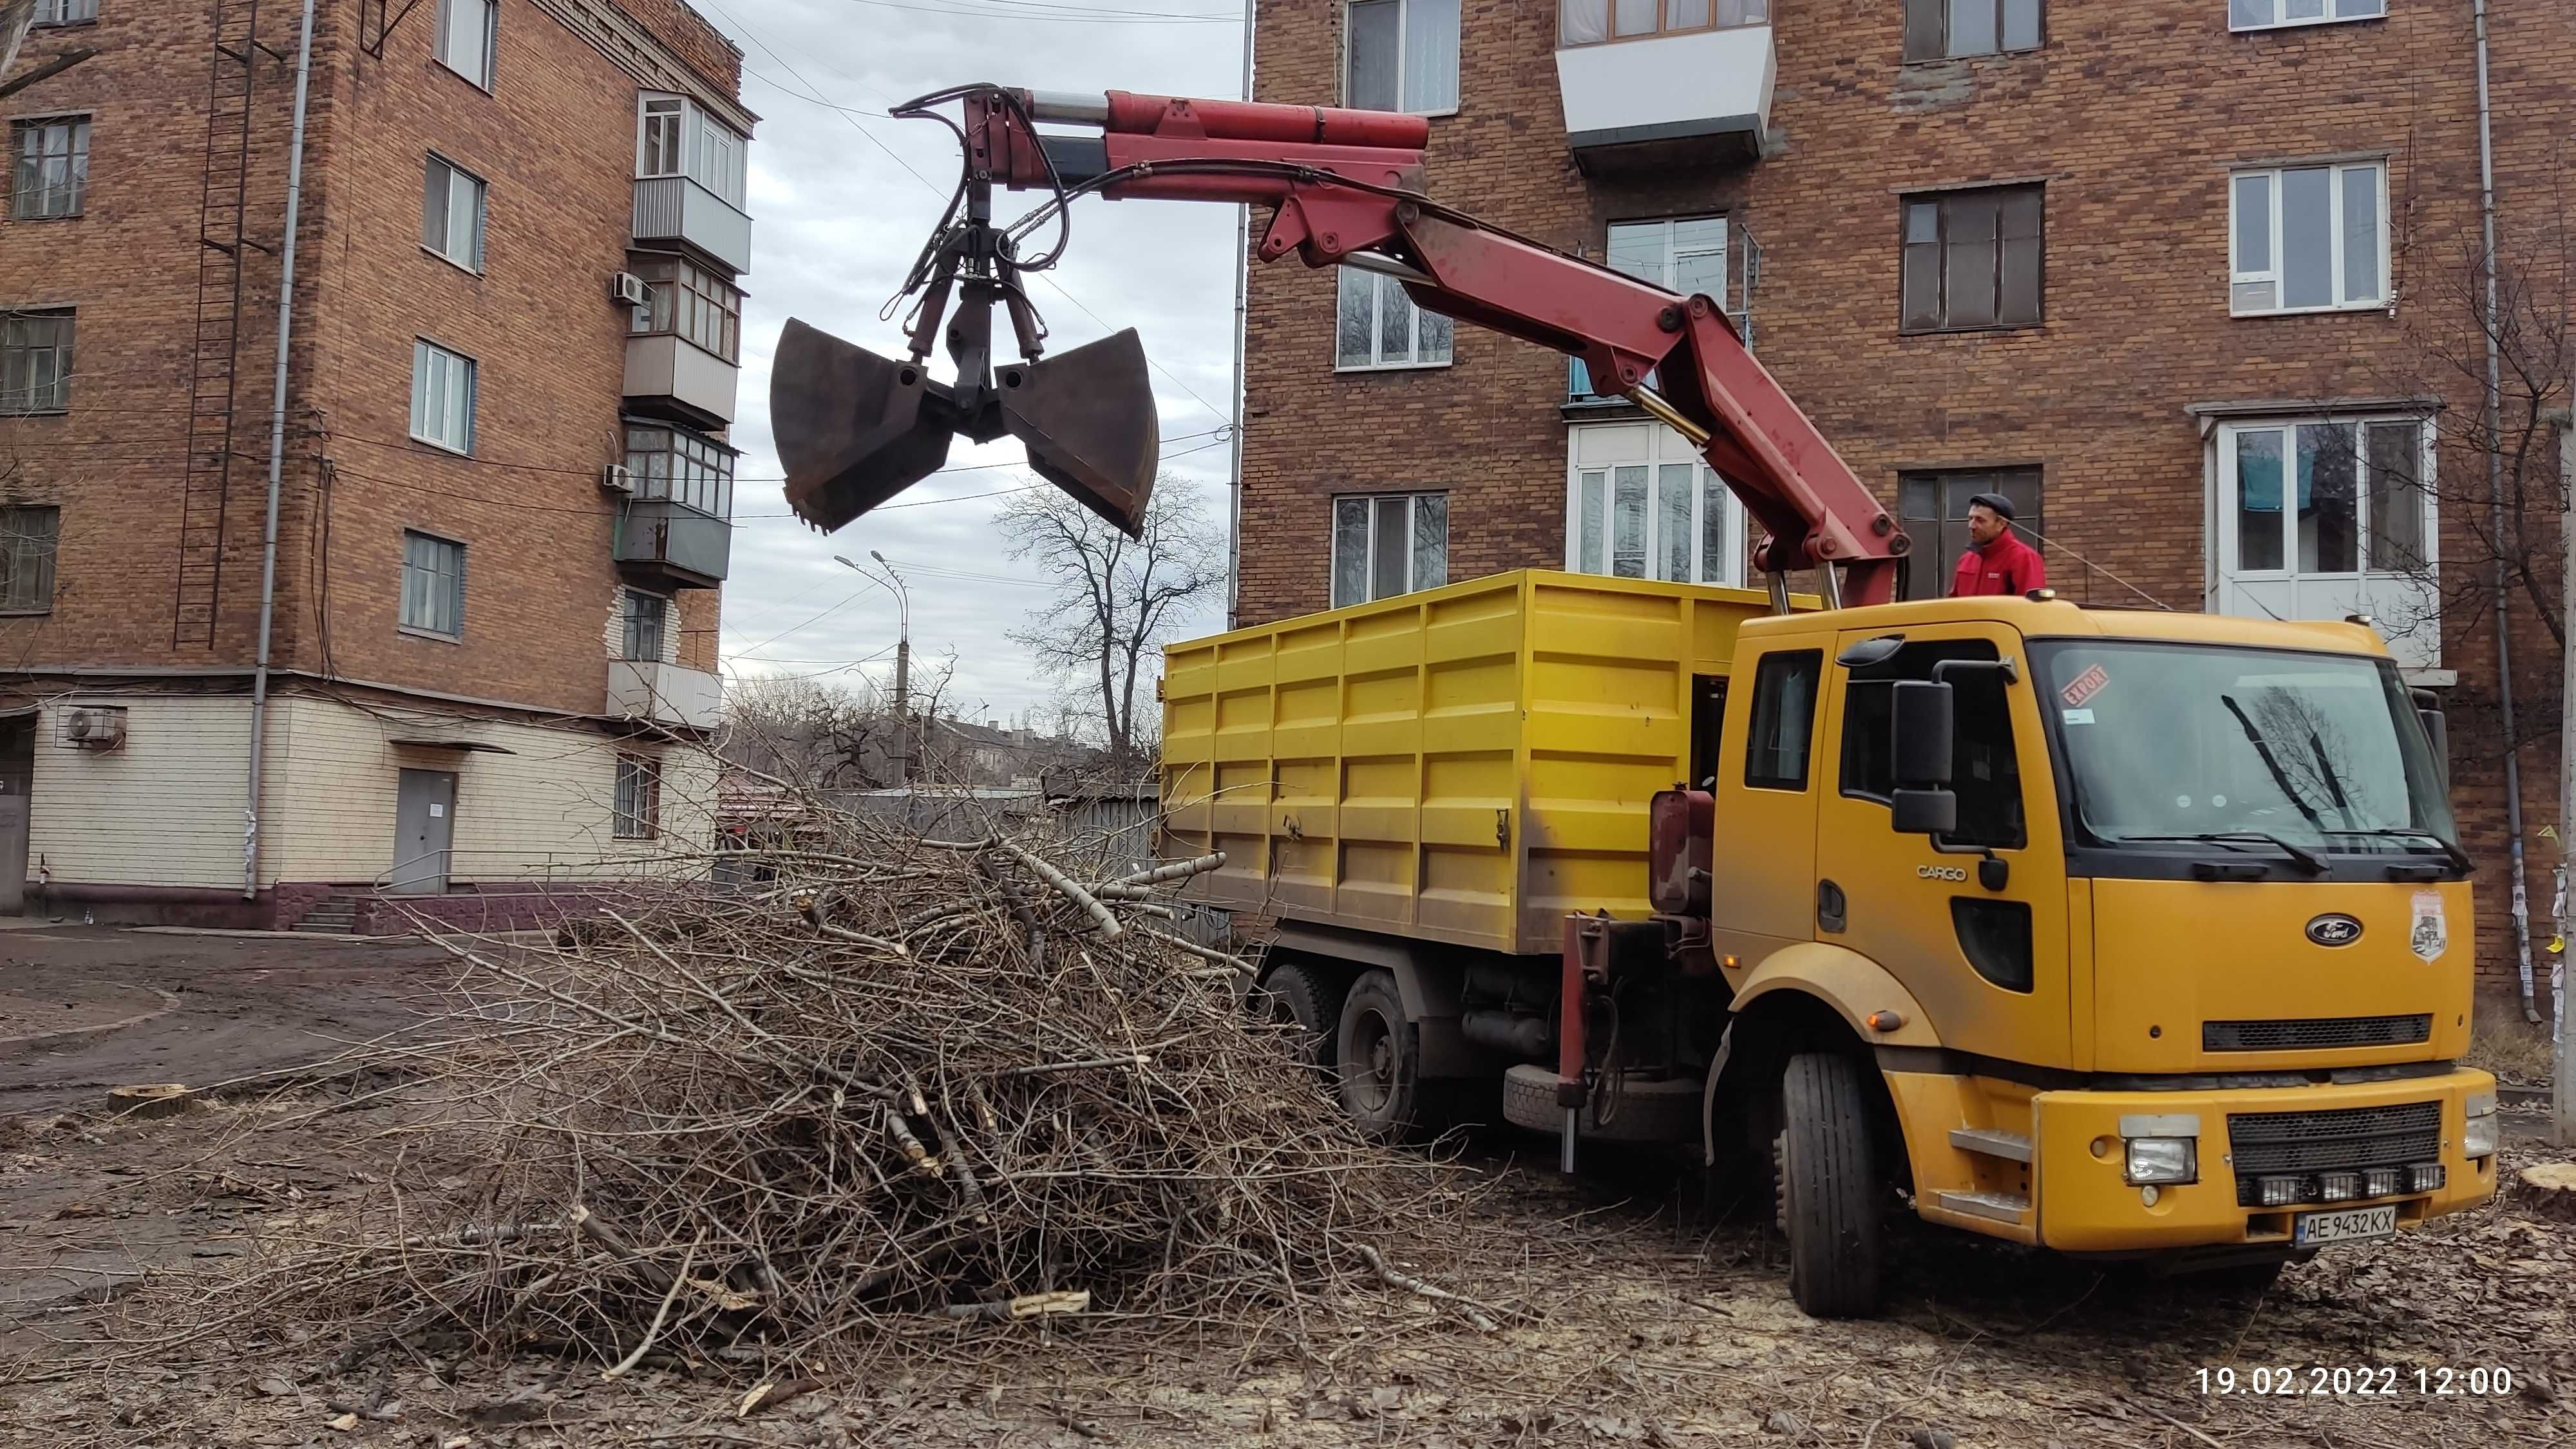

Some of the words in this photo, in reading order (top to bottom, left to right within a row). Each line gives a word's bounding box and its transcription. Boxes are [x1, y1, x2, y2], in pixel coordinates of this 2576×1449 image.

[2063, 666, 2108, 705] EXPORT
[1917, 865, 1967, 881] CARGO
[2324, 922, 2349, 938] Ford
[2306, 1217, 2330, 1239] AE
[2333, 1213, 2369, 1236] 9432
[2371, 1210, 2392, 1232] KX
